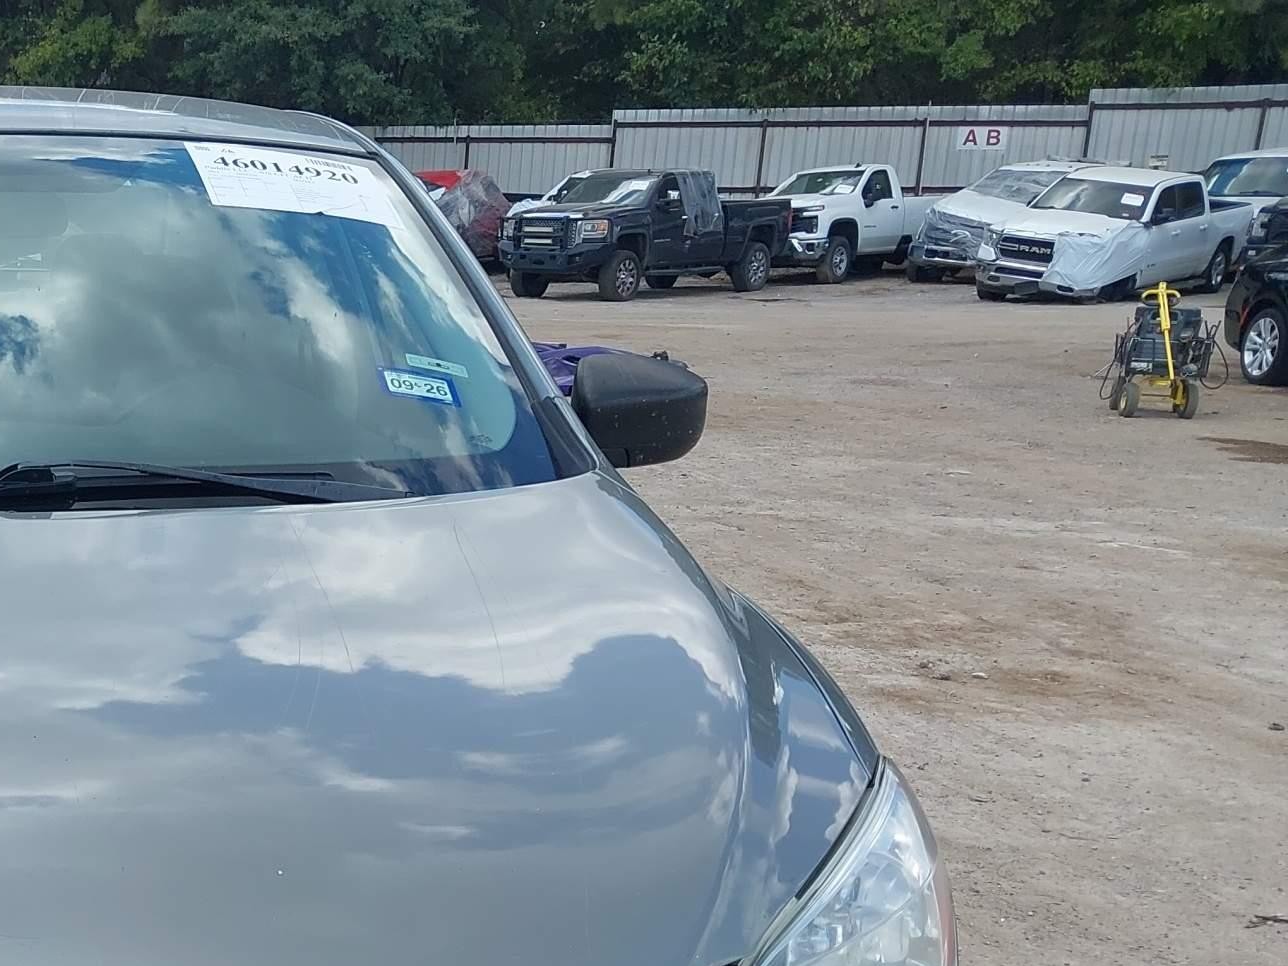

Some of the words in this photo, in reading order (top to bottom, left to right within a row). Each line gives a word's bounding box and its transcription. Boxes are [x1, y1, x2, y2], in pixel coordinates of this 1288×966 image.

[962, 128, 978, 146] A
[986, 128, 1001, 146] B
[213, 156, 359, 185] 46014920
[1019, 244, 1052, 255] RAM
[390, 378, 414, 391] 09
[424, 383, 448, 397] 26
